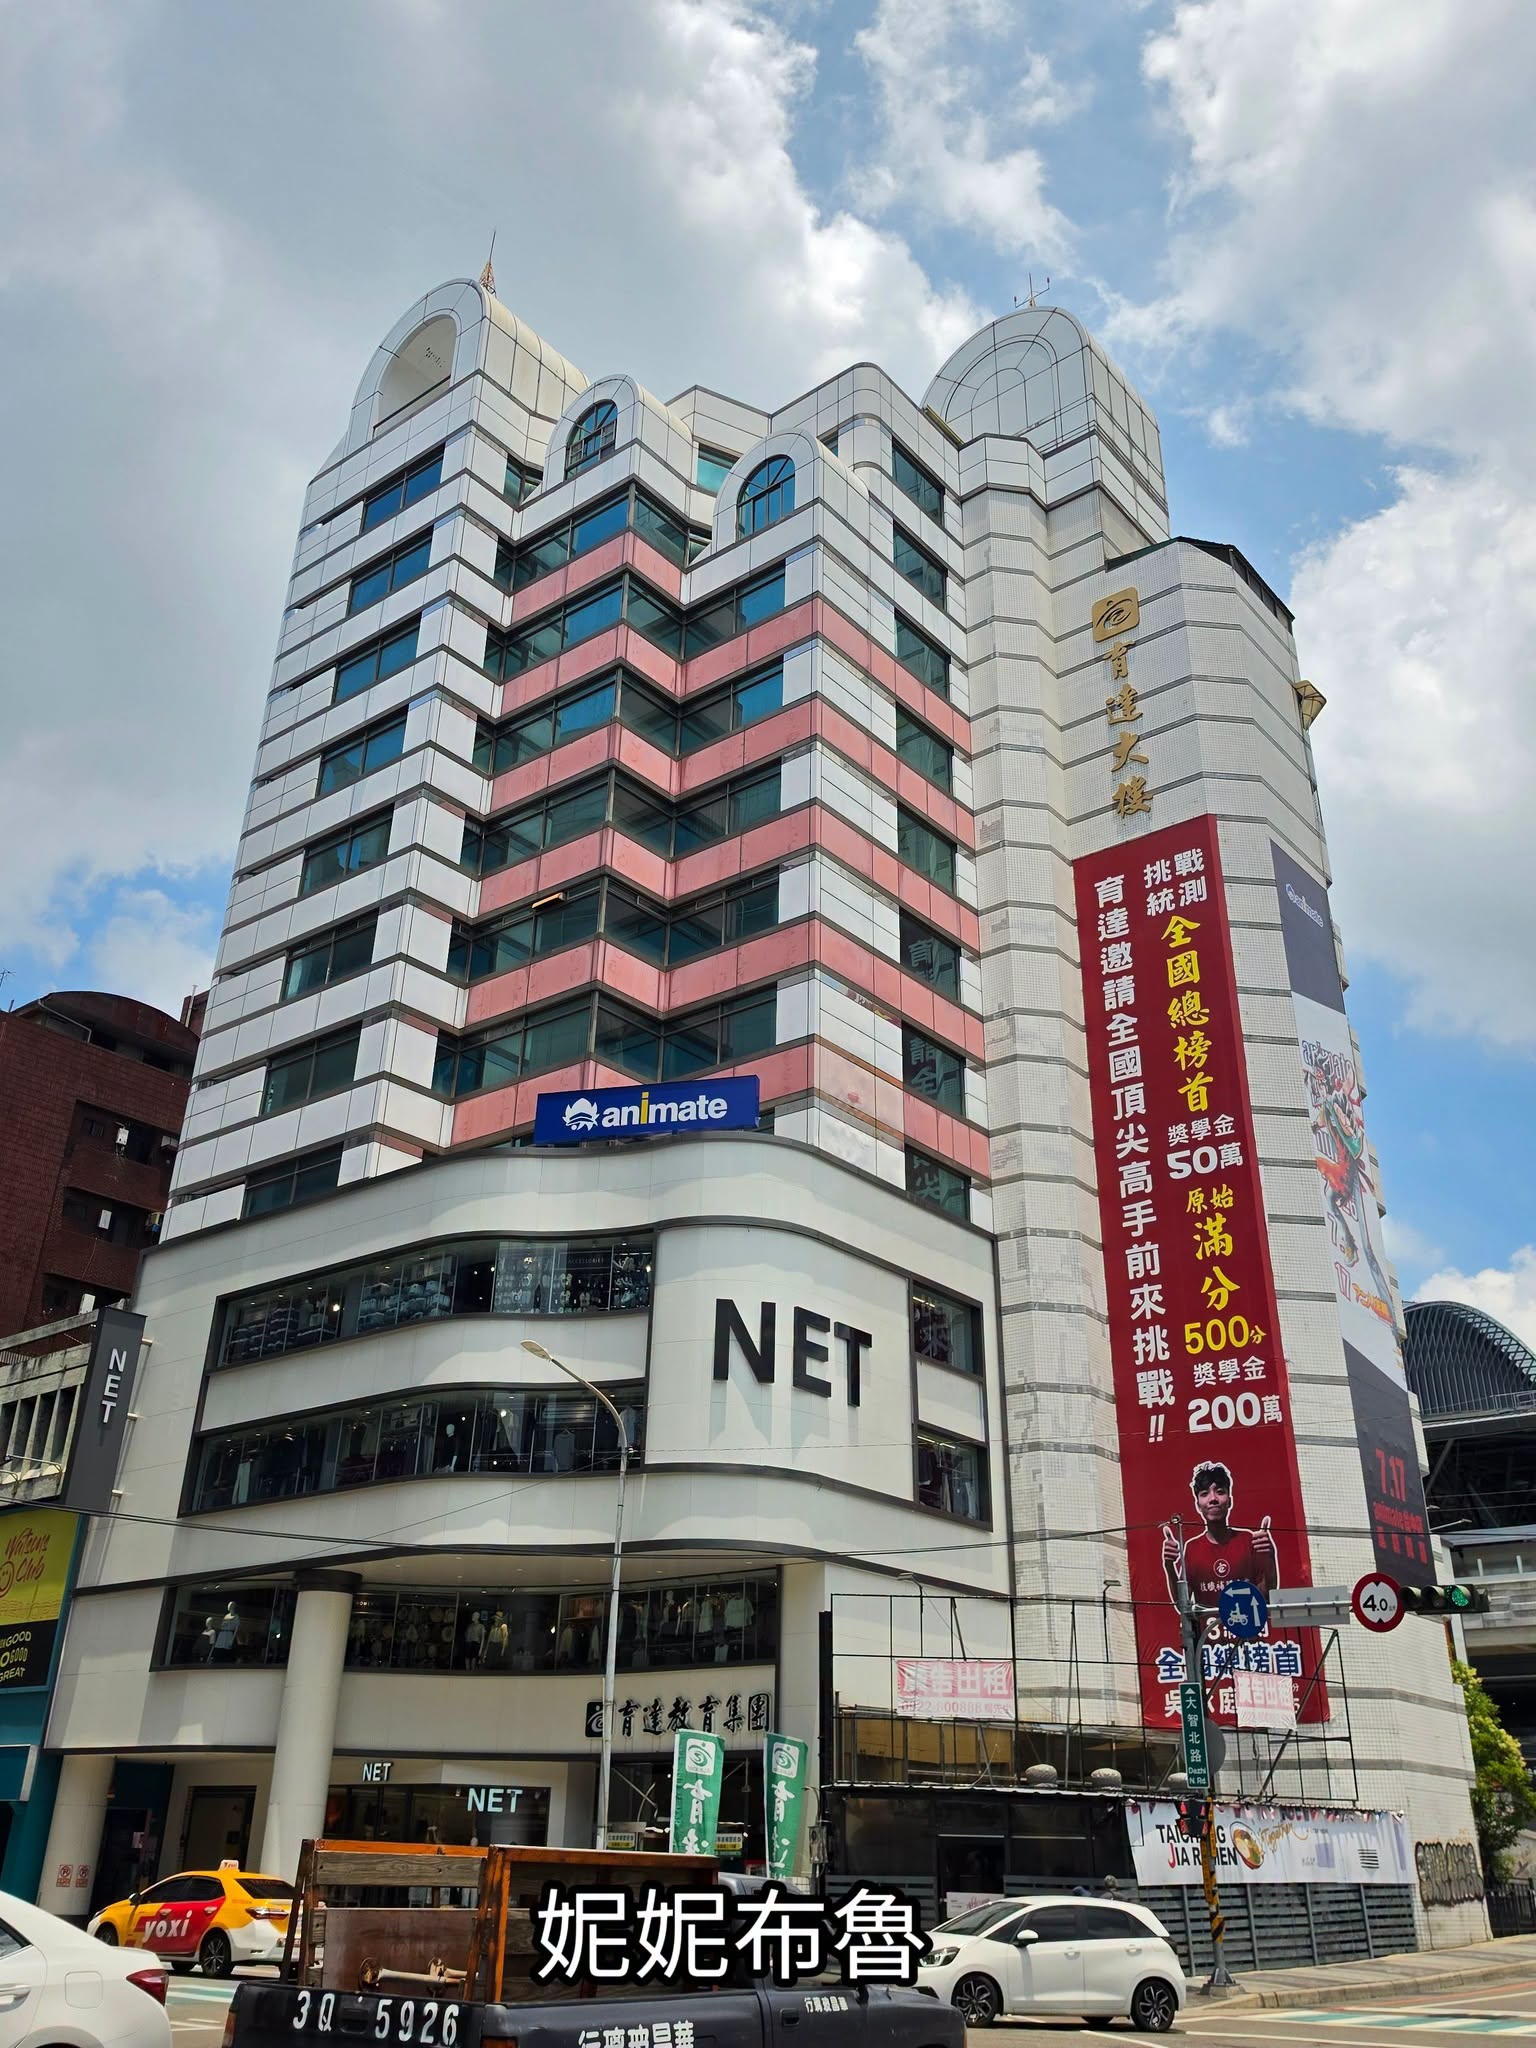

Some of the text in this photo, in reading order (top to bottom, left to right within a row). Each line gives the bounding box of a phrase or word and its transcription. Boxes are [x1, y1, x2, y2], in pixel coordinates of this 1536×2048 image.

[1103, 641, 1153, 817] 育達大樓
[601, 1091, 728, 1128] animate
[713, 1298, 873, 1407] NET
[101, 1348, 127, 1424] NET
[6, 1527, 50, 1557] Watsons
[16, 1556, 46, 1583] Club
[618, 1693, 772, 1737] 育達教育集團
[1185, 1696, 1202, 1763] 大智北路
[362, 1763, 392, 1782] NET
[1188, 1766, 1207, 1775] Dazhi
[466, 1787, 524, 1813] NET
[142, 1910, 191, 1943] yoxi
[374, 1999, 460, 2046] 5926
